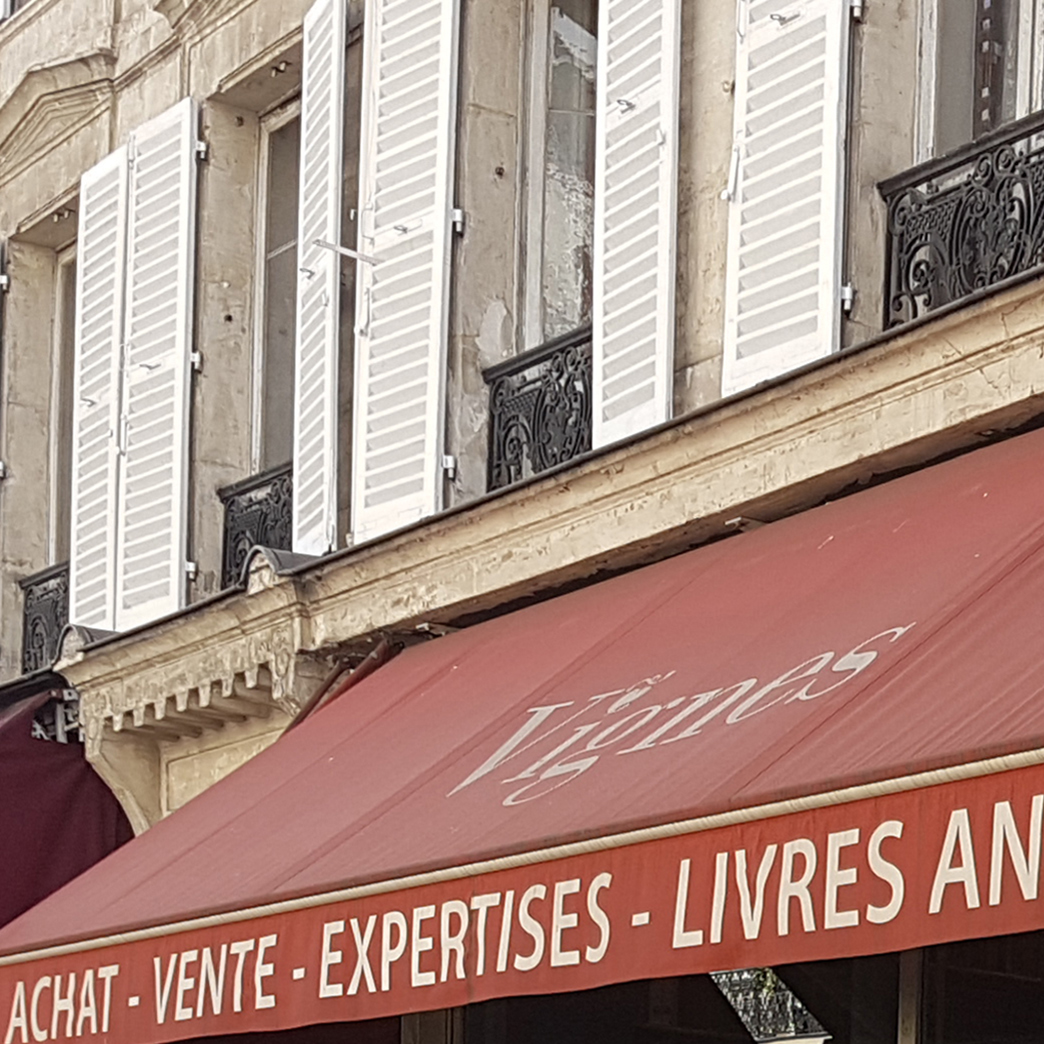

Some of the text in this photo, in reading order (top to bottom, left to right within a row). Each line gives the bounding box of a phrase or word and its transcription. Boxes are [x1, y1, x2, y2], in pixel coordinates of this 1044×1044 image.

[445, 621, 918, 807] Vignes
[153, 933, 278, 1024] VENTE
[318, 872, 614, 999] EXPERTISES
[671, 820, 905, 949] LIVRES
